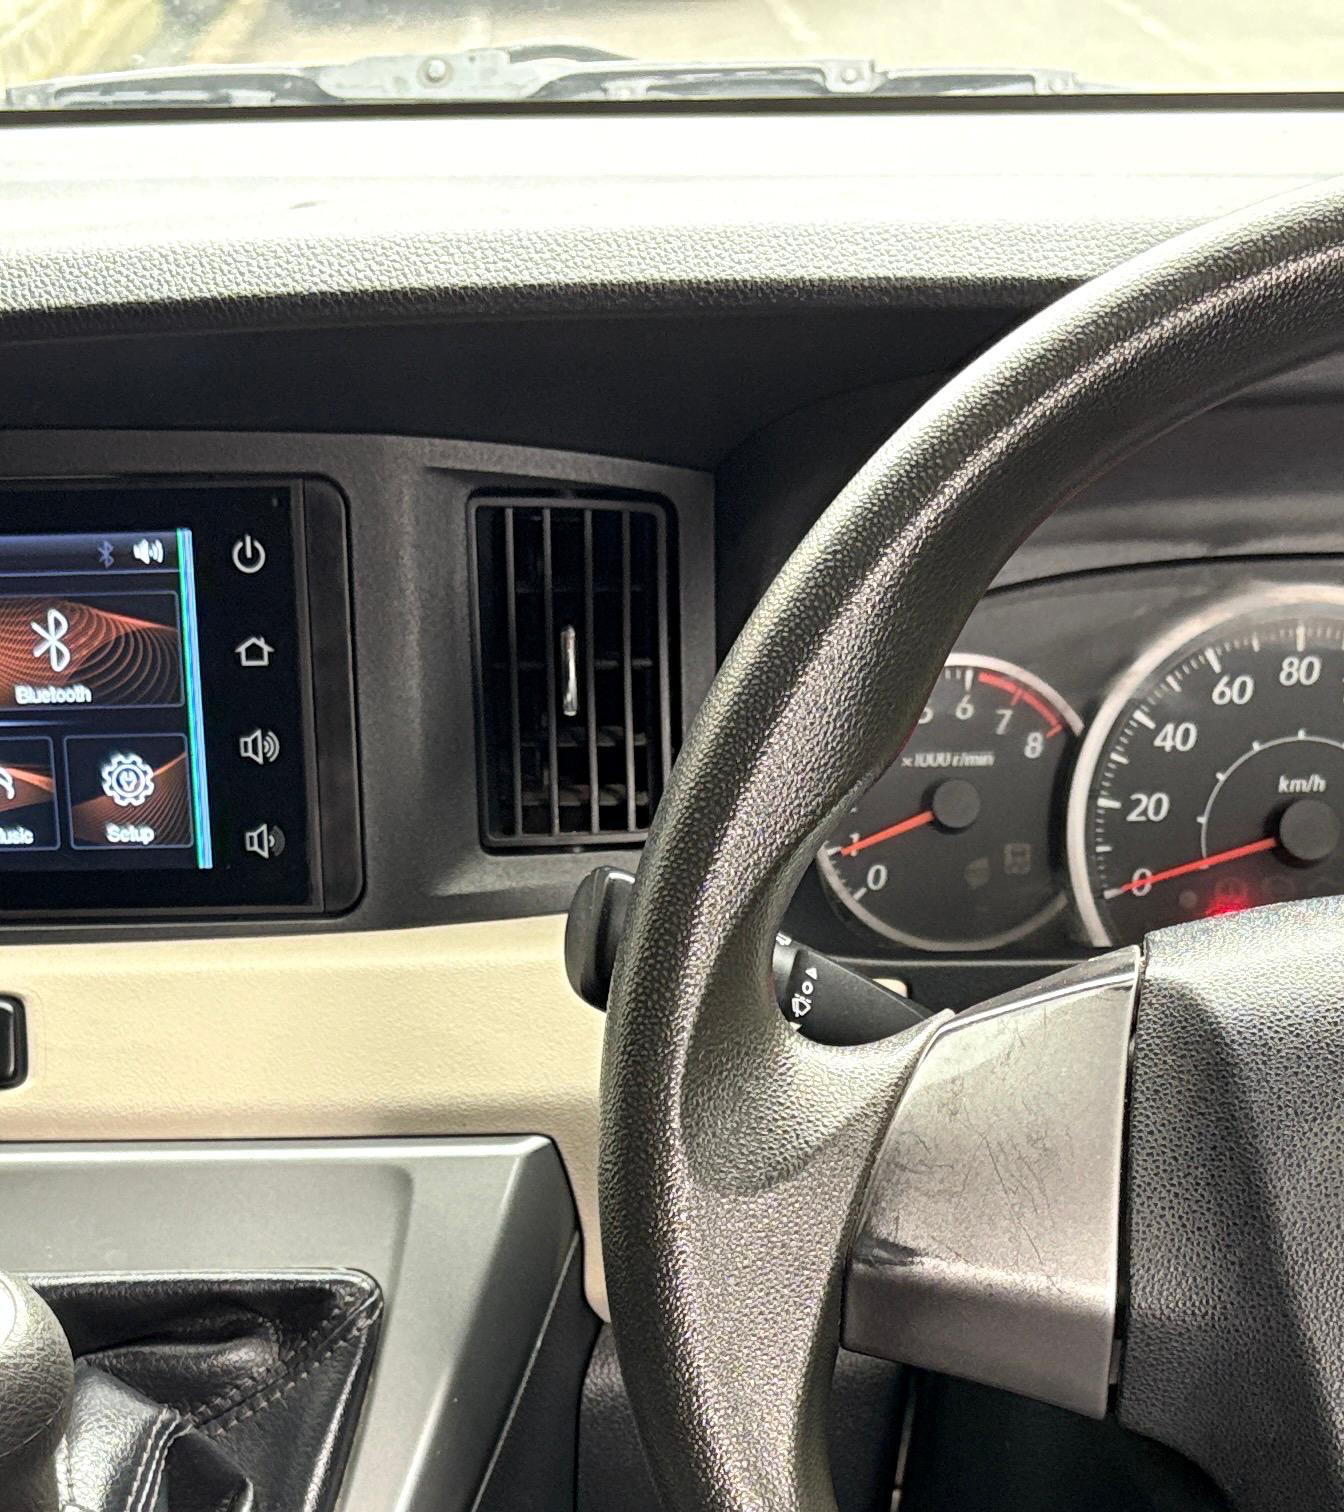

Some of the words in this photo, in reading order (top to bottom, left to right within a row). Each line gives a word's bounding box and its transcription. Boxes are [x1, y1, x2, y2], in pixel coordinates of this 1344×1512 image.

[1279, 655, 1321, 686] 80
[15, 683, 93, 705] Bluetooth
[1211, 675, 1254, 705] 60
[955, 694, 974, 720] 6
[995, 708, 1013, 735] 7
[1024, 731, 1044, 759] 8
[1153, 722, 1197, 753] 40
[1278, 772, 1327, 794] km/h
[1126, 793, 1170, 823] 20
[107, 823, 155, 846] Setup
[867, 863, 888, 890] 0
